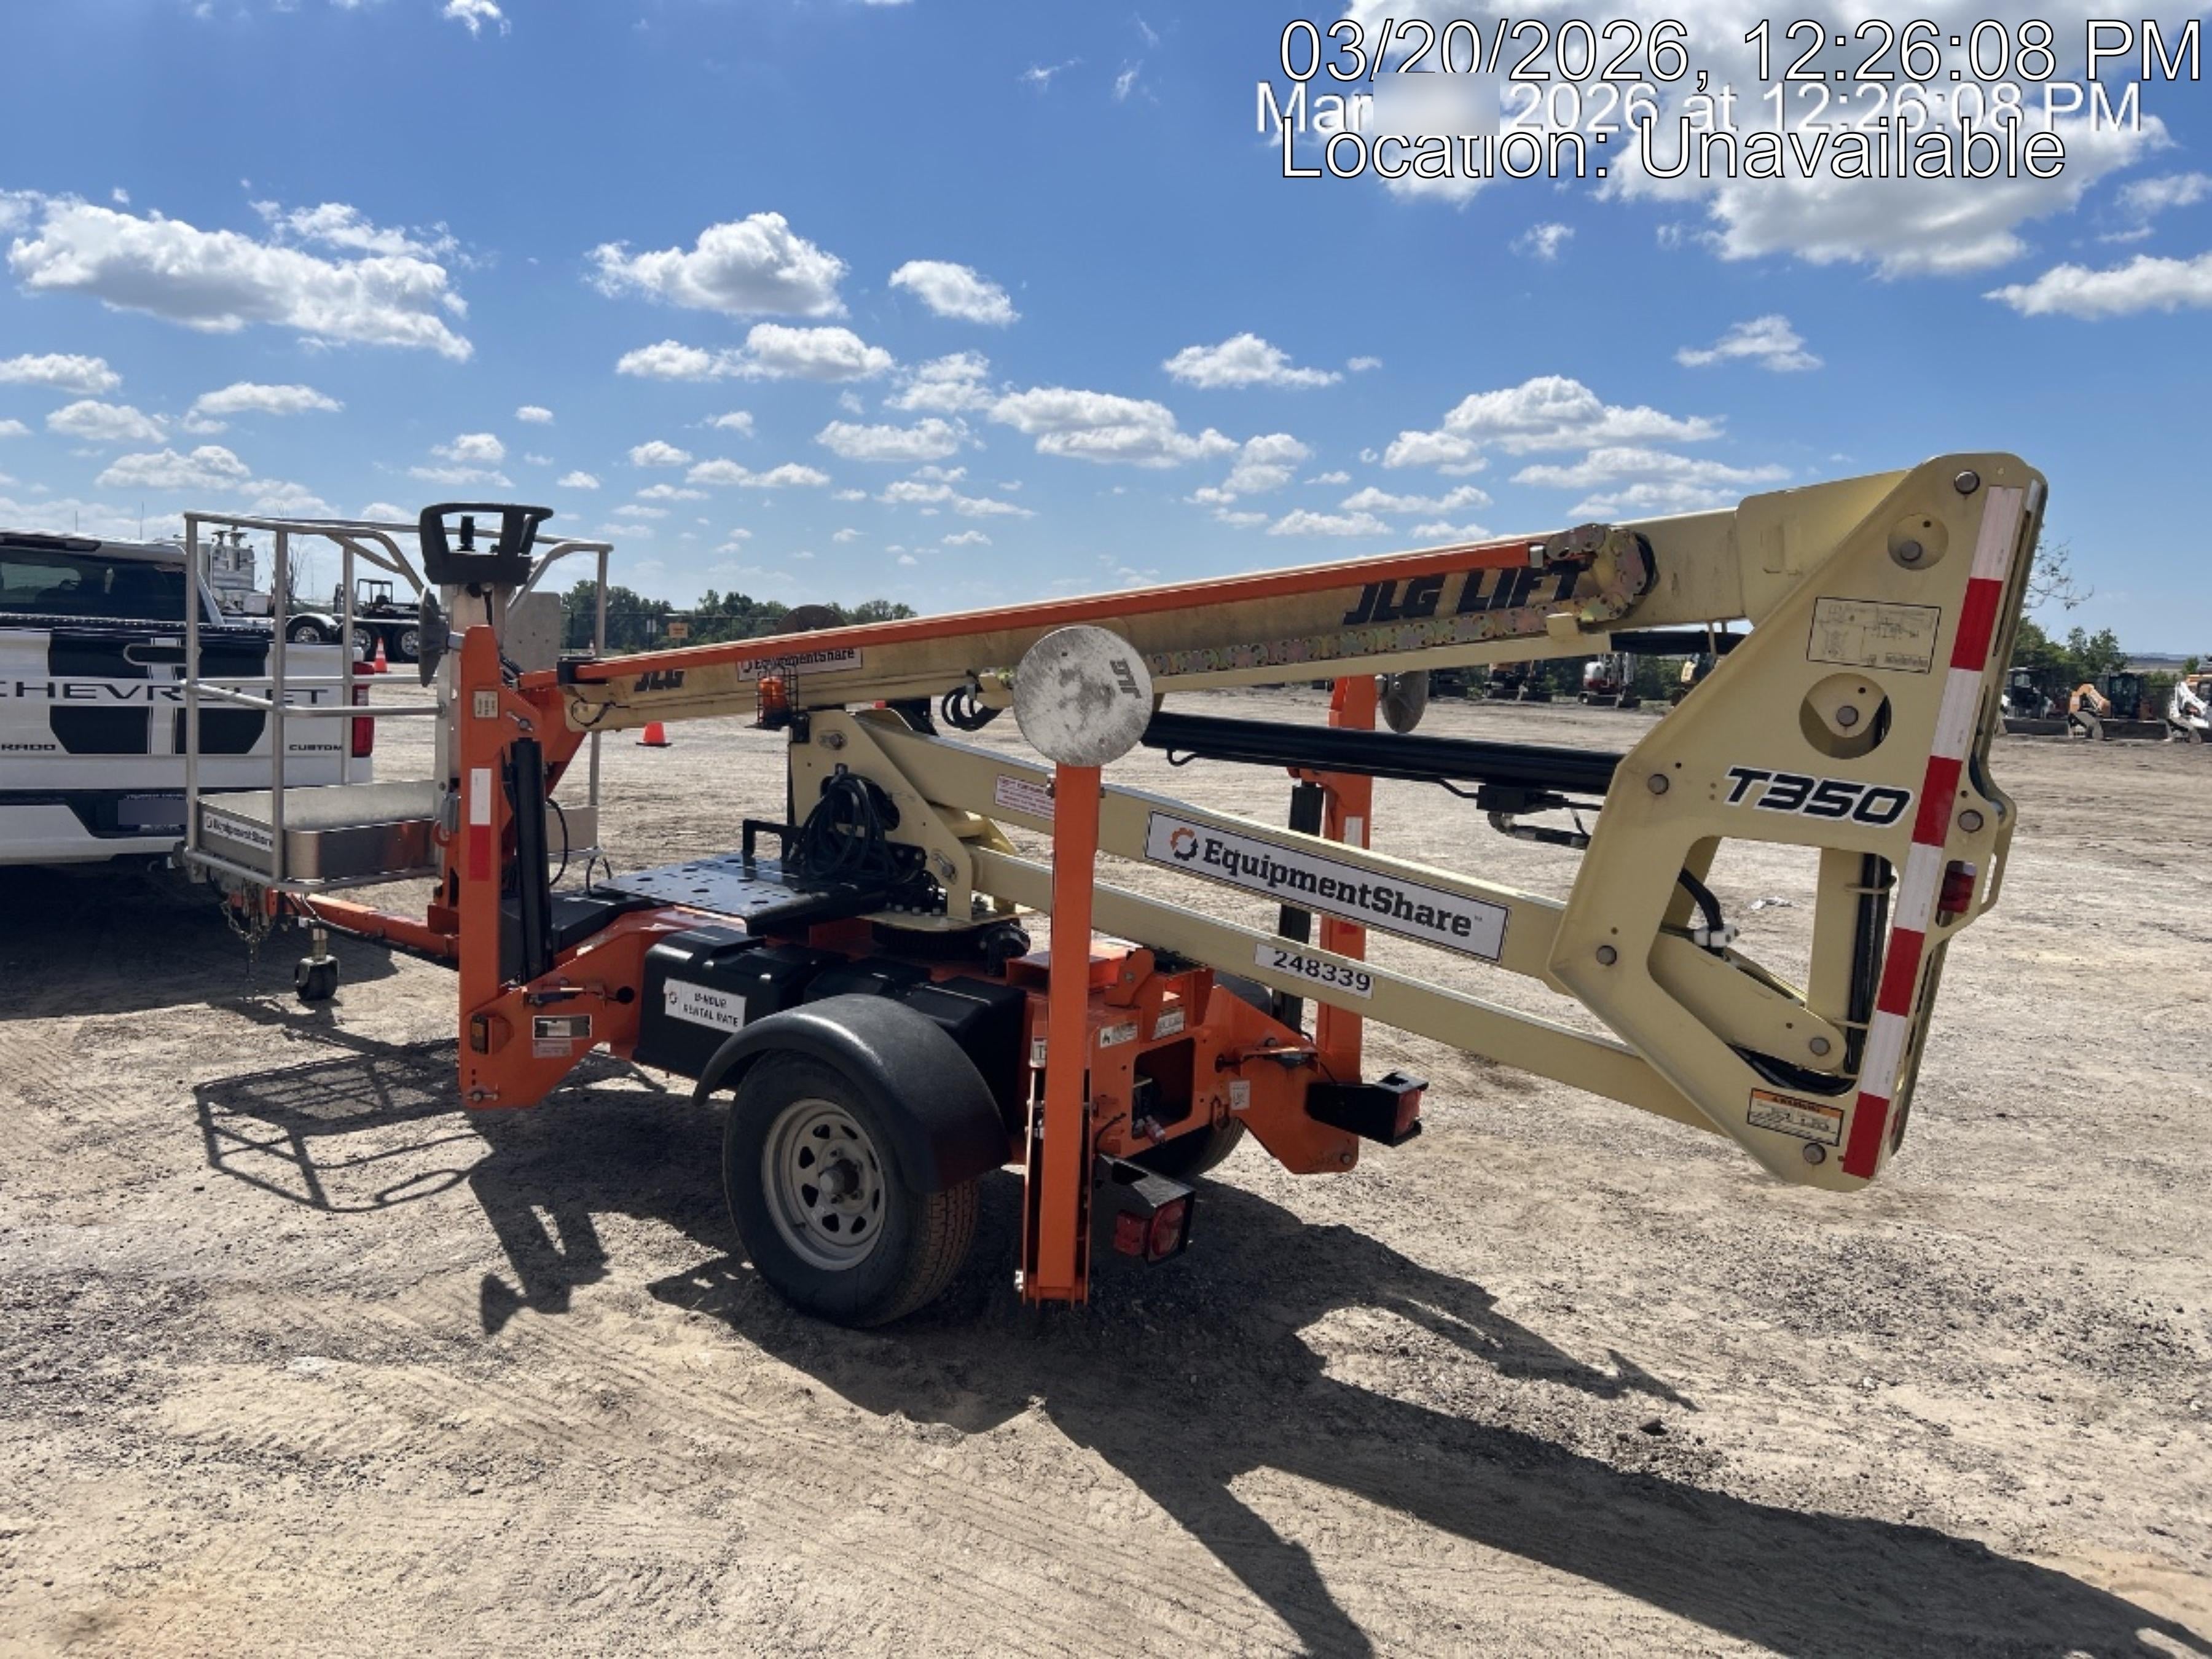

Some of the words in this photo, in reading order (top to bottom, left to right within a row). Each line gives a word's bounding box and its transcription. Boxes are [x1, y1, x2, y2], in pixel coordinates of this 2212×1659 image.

[1343, 573, 1446, 626] JLG
[1456, 560, 1593, 614] LIFT
[1110, 658, 1142, 699] JLG
[1725, 766, 1913, 826] T350
[1203, 837, 1472, 938] EquipmentShare
[1273, 949, 1371, 992] 248339
